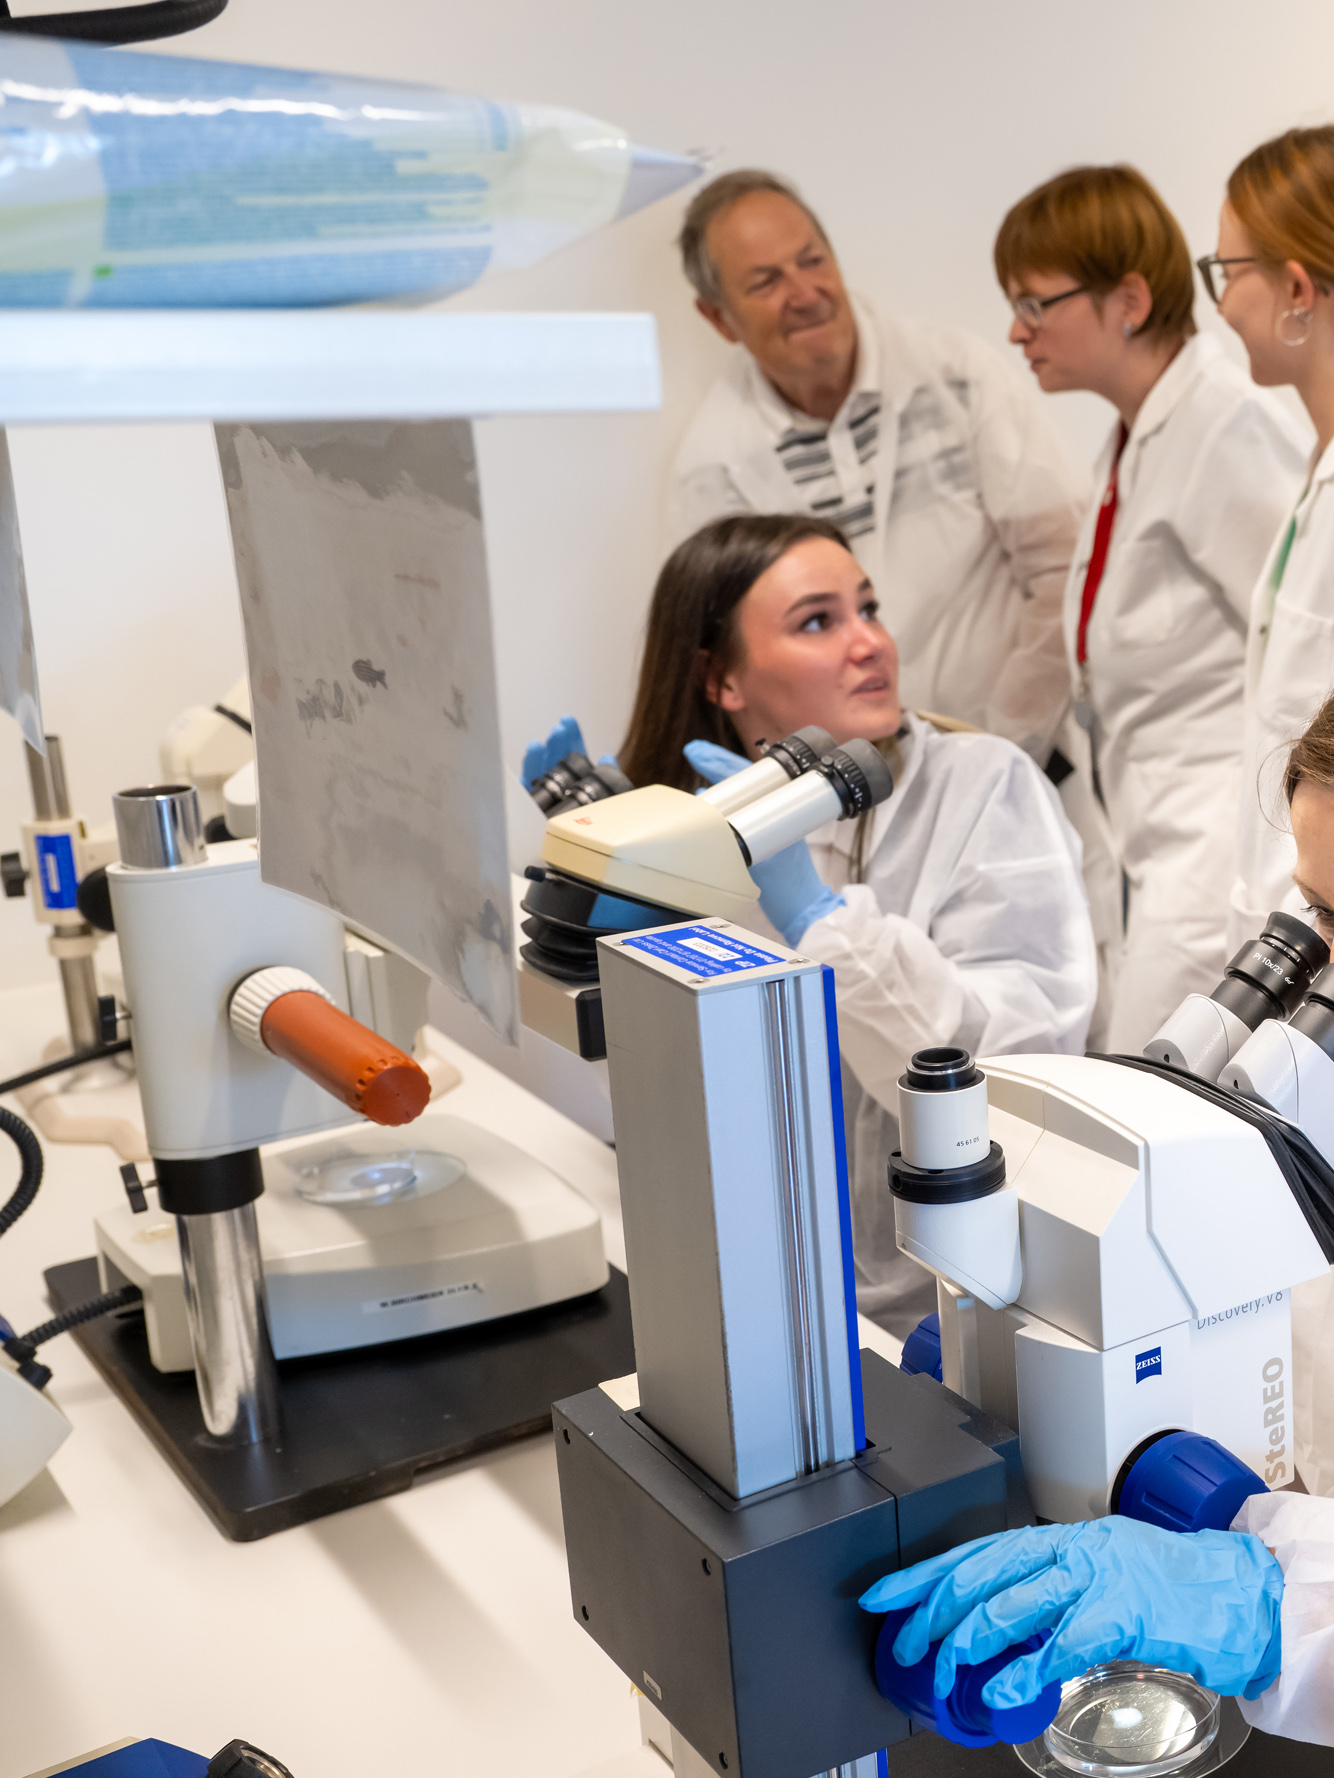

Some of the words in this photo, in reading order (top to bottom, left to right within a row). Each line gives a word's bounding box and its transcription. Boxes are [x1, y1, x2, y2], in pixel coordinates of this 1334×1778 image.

[1262, 957, 1284, 975] 10x/23
[1136, 1354, 1161, 1371] ZEISS
[1262, 1357, 1286, 1484] SteREO
